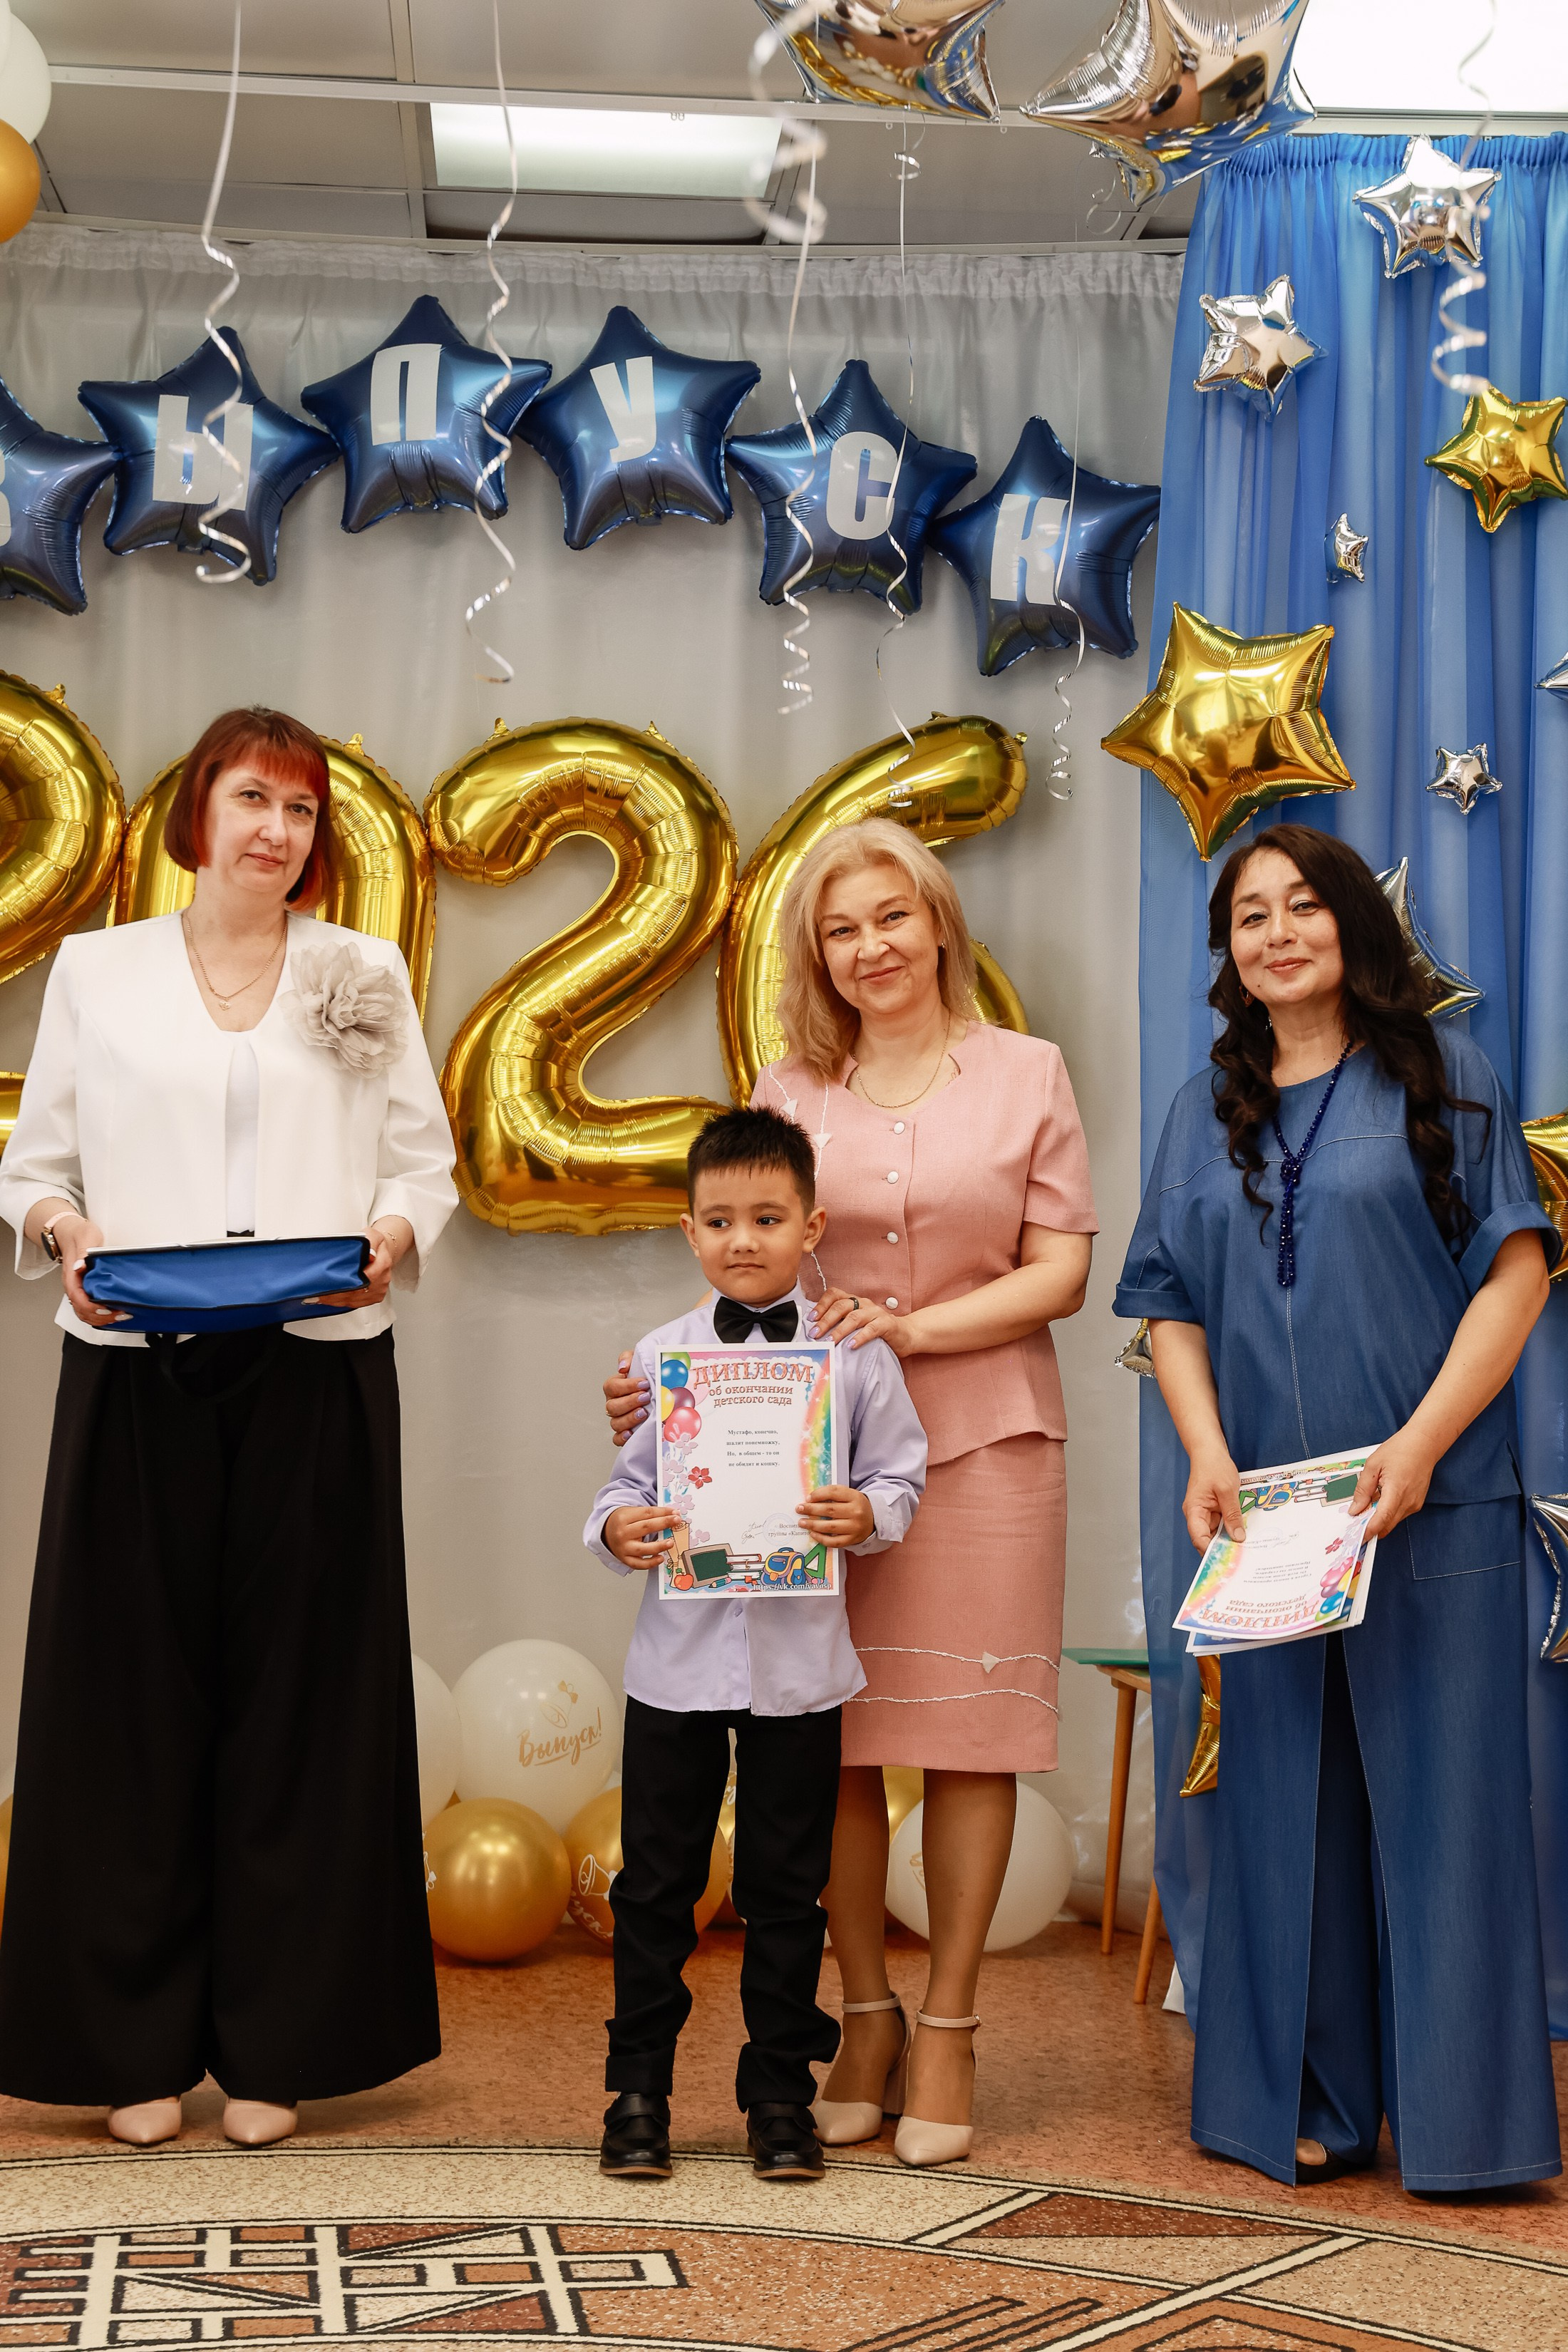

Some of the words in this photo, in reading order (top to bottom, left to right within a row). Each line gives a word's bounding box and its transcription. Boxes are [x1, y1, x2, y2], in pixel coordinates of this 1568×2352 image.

[0, 343, 1071, 606] ЫПУСК
[691, 1361, 813, 1390] ДИПЛОМ
[708, 1386, 722, 1396] об
[725, 1386, 793, 1395] окончании
[713, 1396, 764, 1408] детского
[767, 1396, 793, 1406] сада
[1257, 1594, 1306, 1608] детского
[1294, 1601, 1307, 1610] об
[1199, 1599, 1319, 1629] ДИПЛОМ
[1225, 1605, 1294, 1614] окончании
[517, 1706, 602, 1768] Выпуск!
